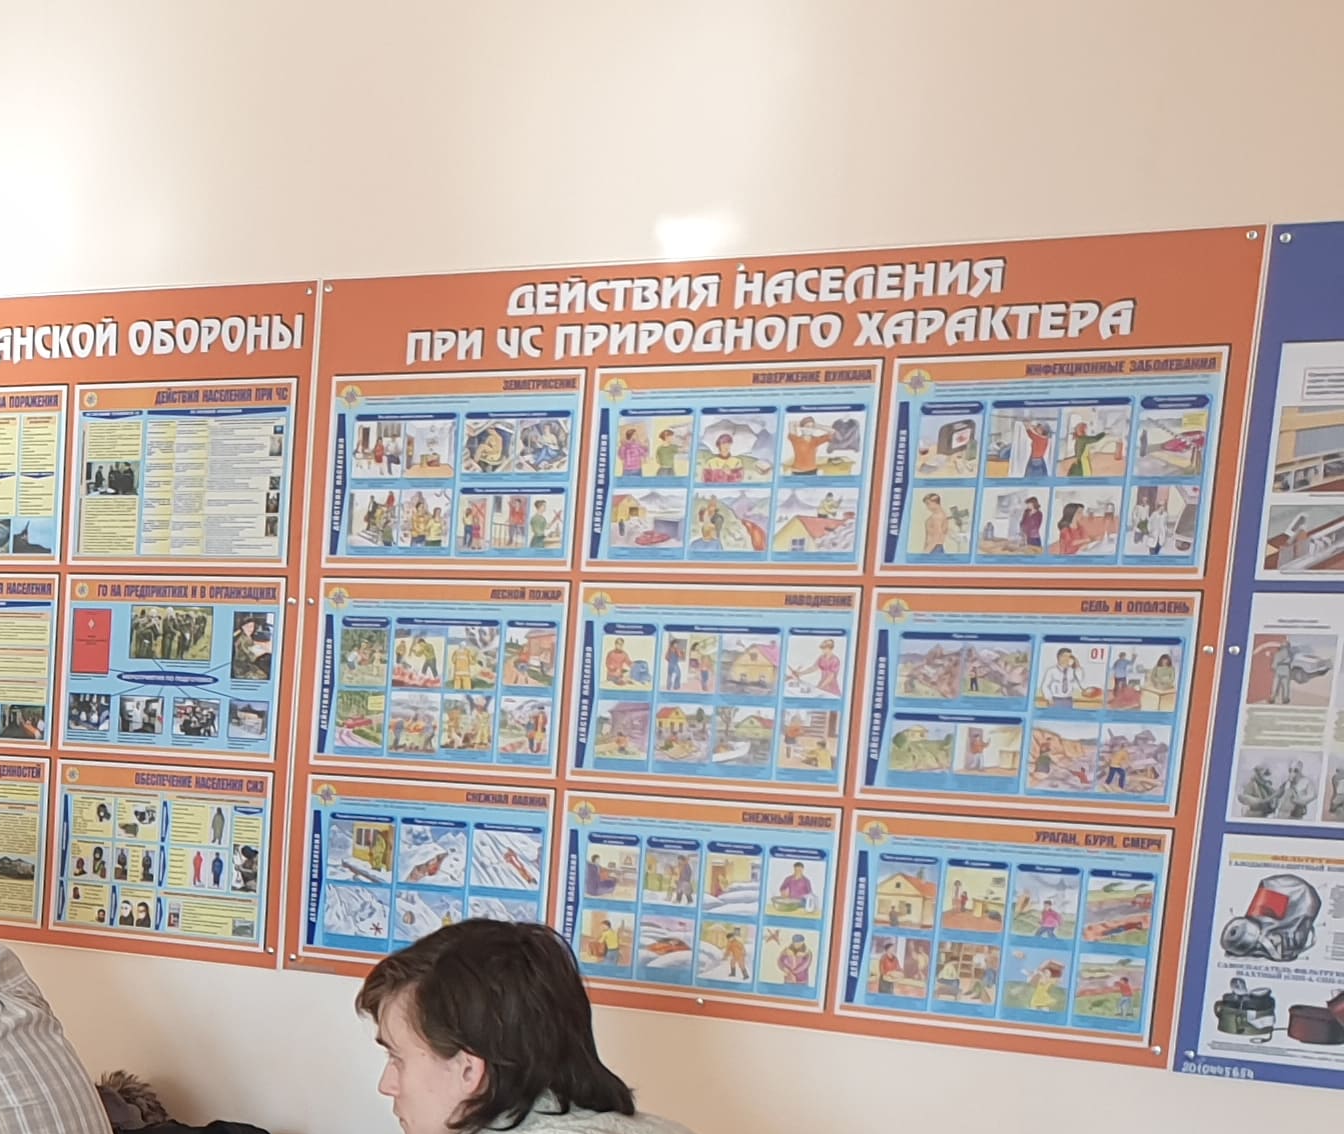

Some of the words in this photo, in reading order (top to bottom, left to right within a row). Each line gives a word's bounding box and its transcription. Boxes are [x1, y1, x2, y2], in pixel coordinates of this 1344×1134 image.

[506, 269, 720, 319] ДЕЙСТВИЯ
[736, 258, 1005, 310] НАСЕЛЕНИЯ
[128, 313, 306, 358] ОБОРОНЫ
[406, 329, 485, 366] ПРИ
[495, 325, 542, 359] ЧС
[553, 312, 843, 361] ПРИРОДНОГО
[853, 297, 1135, 349] ХАРАКТЕРА
[1026, 361, 1124, 376] ИНФЕКЦИОННЫЕ
[1129, 357, 1217, 372] ЗАБОЛЕВАНИЯ
[752, 370, 820, 384] ИЗВЕРЖЕНИЕ
[824, 369, 872, 382] ВУЛКАНА
[503, 378, 577, 391] ЗЕМЛЕТРЯСЕНИЕ
[8, 394, 59, 409] ПОРАЖЕНИЯ
[155, 388, 199, 405] ДЕЙСТВИЯ
[202, 388, 252, 403] НАСЕЛЕНИЯ
[255, 388, 273, 401] ПРИ
[276, 387, 288, 400] ЧС
[6, 582, 52, 595] НАСЕЛЕНИЯ
[98, 584, 108, 597] ГО
[111, 585, 121, 597] НА
[124, 585, 188, 599] ПРЕДПРИЯТИЯХ
[192, 586, 197, 598] И
[201, 586, 206, 599] В
[210, 586, 276, 600] ОРГАНИЗАЦИЯХ
[490, 587, 526, 600] ЛЕСНОЙ
[529, 589, 562, 600] ПОЖАР
[784, 593, 852, 607] НАВОДНЕНИЕ
[1081, 600, 1110, 612] СЕЛЬ
[1114, 601, 1122, 612] И
[1127, 600, 1190, 614] ОПОЛЗЕНЬ
[1090, 647, 1104, 660] 01
[135, 772, 192, 788] ОБЕСПЕЧЕНИЕ
[195, 775, 244, 791] НАСЕЛЕНИЯ
[246, 780, 264, 793] СИЗ
[465, 792, 509, 804] СНЕЖНАЯ
[511, 794, 547, 807] ЛАВИНА
[742, 811, 794, 825] СНЕЖНЫЙ
[798, 814, 833, 828] ЗАНОС
[1035, 831, 1079, 845] УРАГАН,
[1122, 836, 1162, 849] СМЕРЧ
